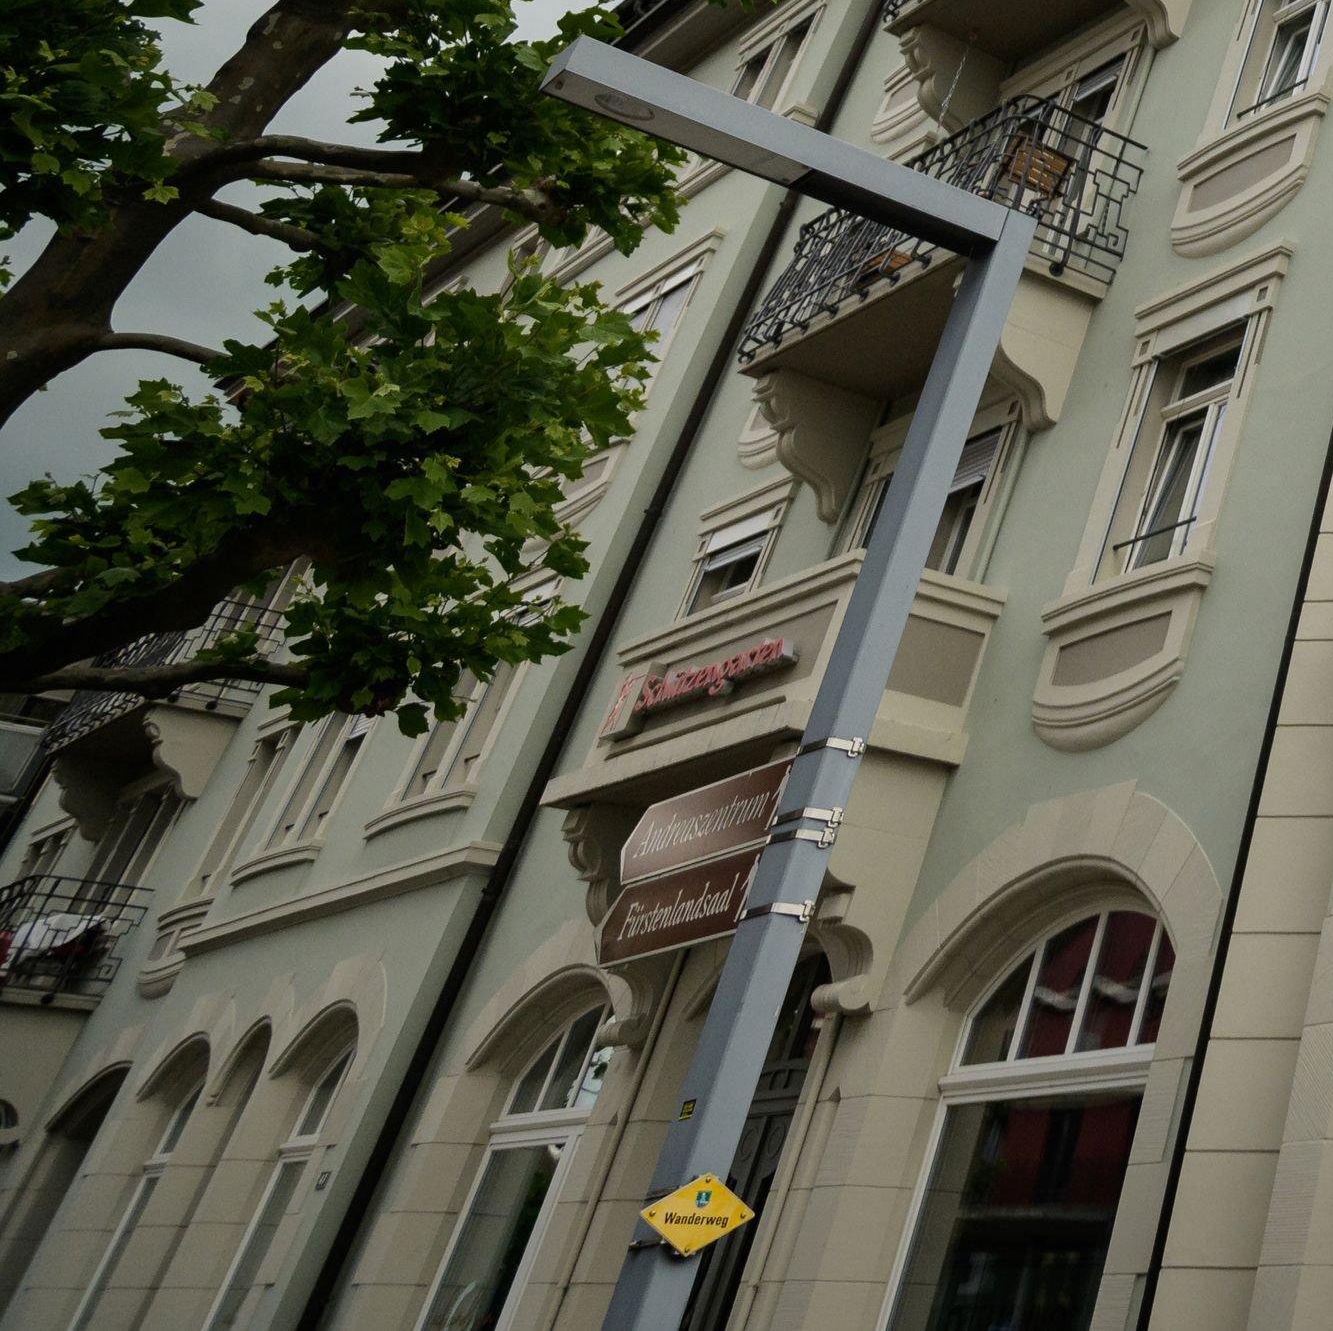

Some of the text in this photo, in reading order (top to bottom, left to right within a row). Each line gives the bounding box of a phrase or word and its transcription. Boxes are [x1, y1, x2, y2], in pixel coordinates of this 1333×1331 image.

[632, 791, 770, 860] Andreaszentrum
[616, 871, 741, 942] Fürstenlandsaal
[664, 1211, 729, 1228] Wanderweg
